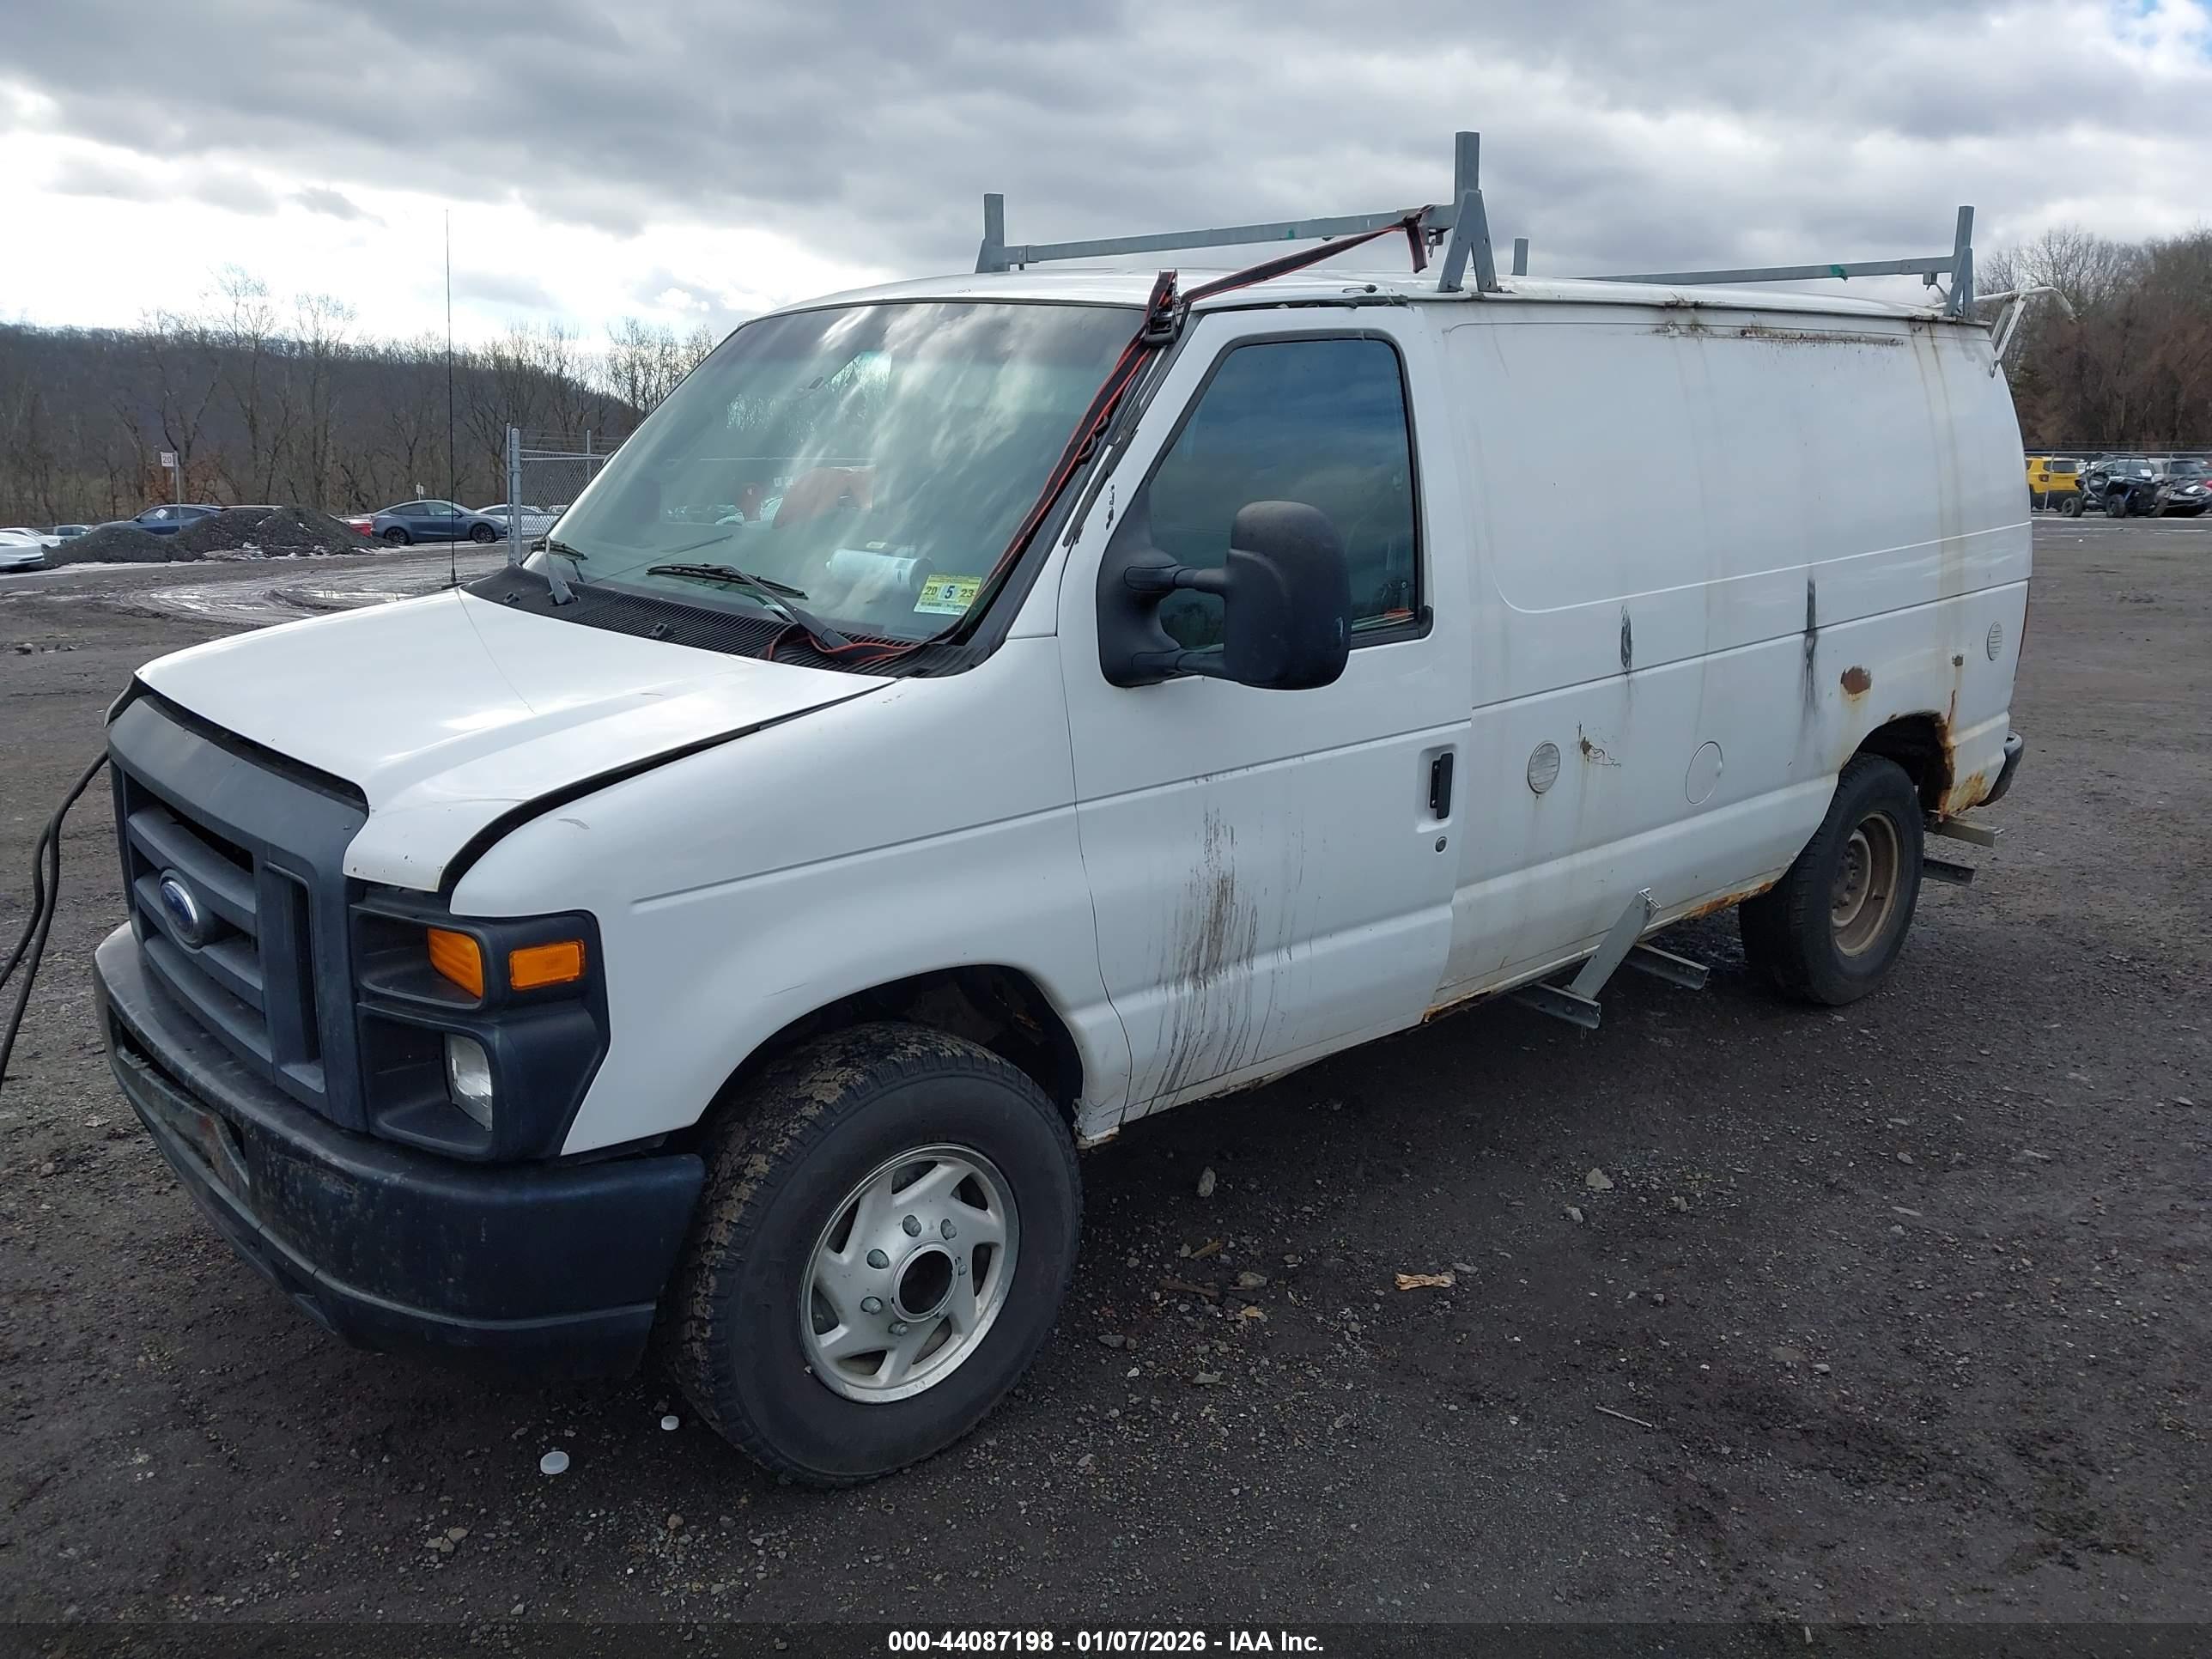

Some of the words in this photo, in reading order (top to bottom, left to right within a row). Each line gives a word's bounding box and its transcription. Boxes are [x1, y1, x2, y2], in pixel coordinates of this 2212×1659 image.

[162, 455, 173, 464] 20
[925, 586, 938, 596] 20
[945, 585, 956, 599] 5
[960, 588, 975, 598] 23
